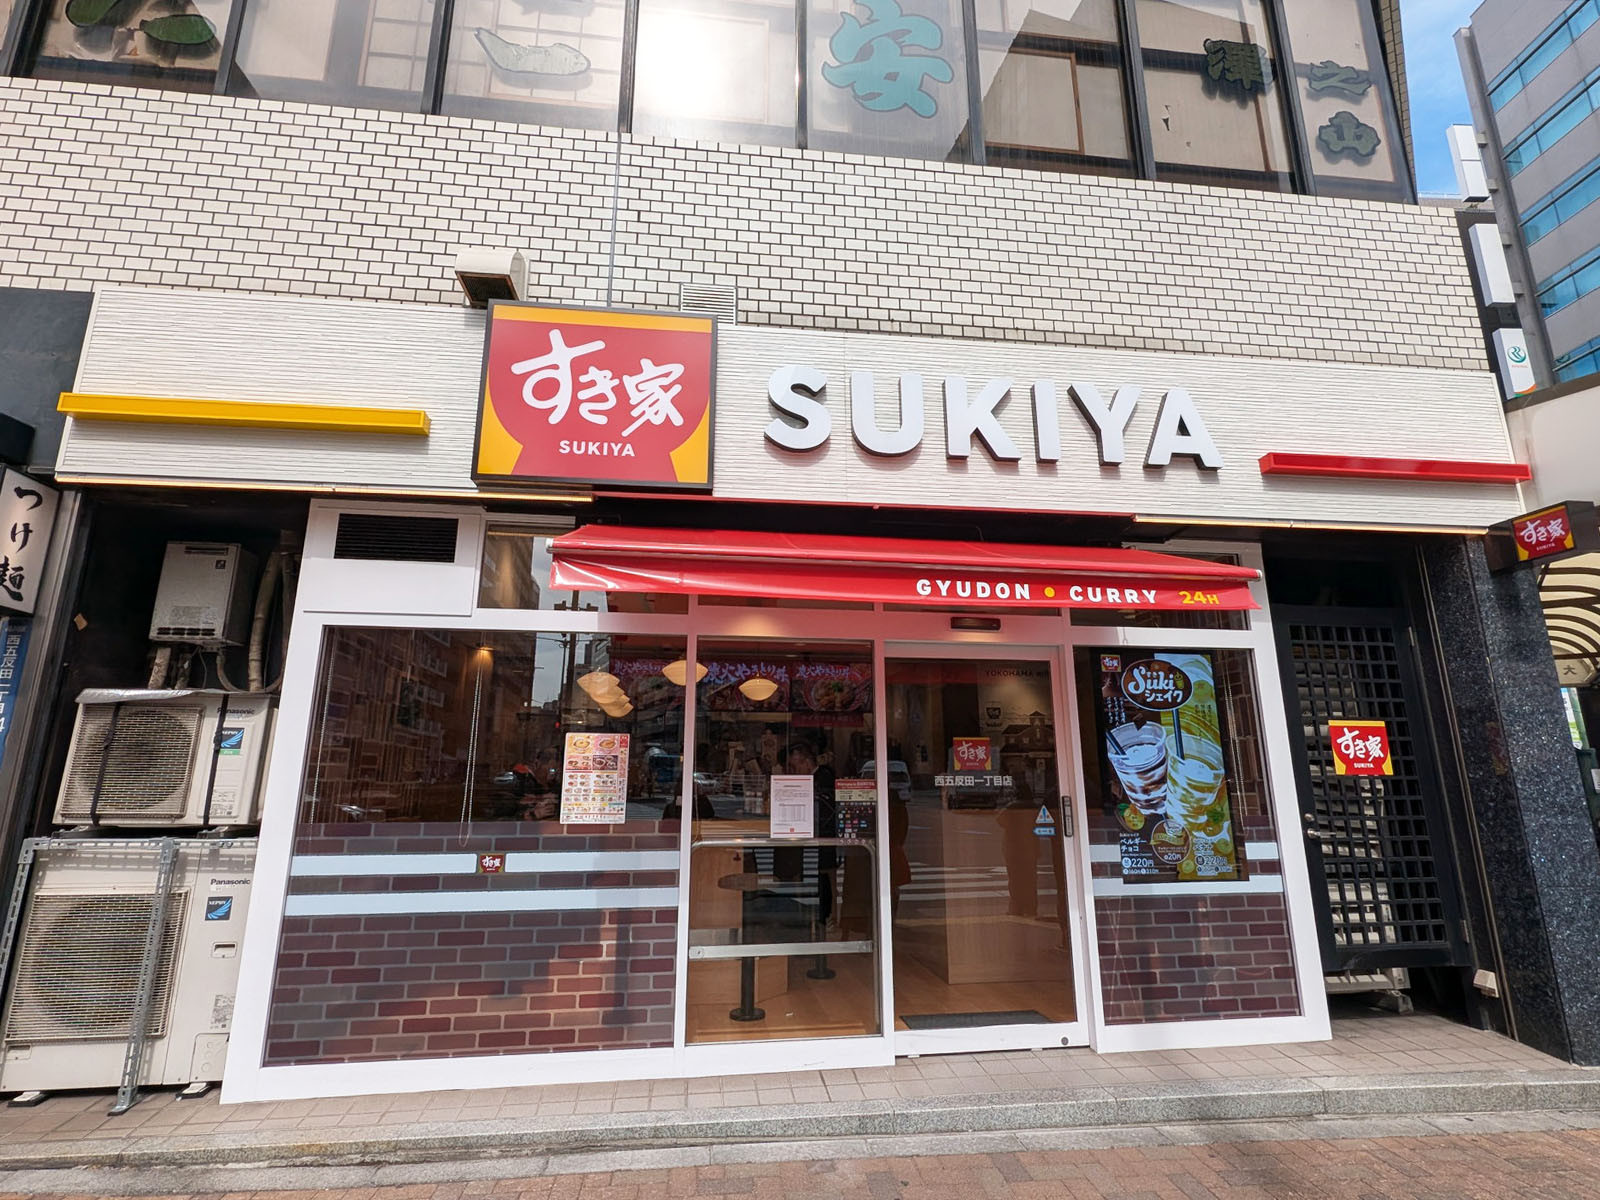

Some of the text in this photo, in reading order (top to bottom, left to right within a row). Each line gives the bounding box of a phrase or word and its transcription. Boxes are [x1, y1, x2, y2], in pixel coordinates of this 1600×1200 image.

[510, 328, 686, 437] すき家
[763, 365, 1223, 472] SUKIYA
[558, 439, 636, 458] SUKIYA
[1520, 517, 1566, 545] すき家
[0, 486, 43, 602] つけ麺
[916, 579, 1220, 605] GYUDON CURRY 24H
[1563, 664, 1576, 676] 大
[1144, 690, 1183, 702] シェイク
[217, 706, 255, 715] Pnasonic
[957, 740, 987, 761] すき家
[1336, 727, 1385, 762] すき家
[934, 775, 1013, 787] 西五反田一丁目店
